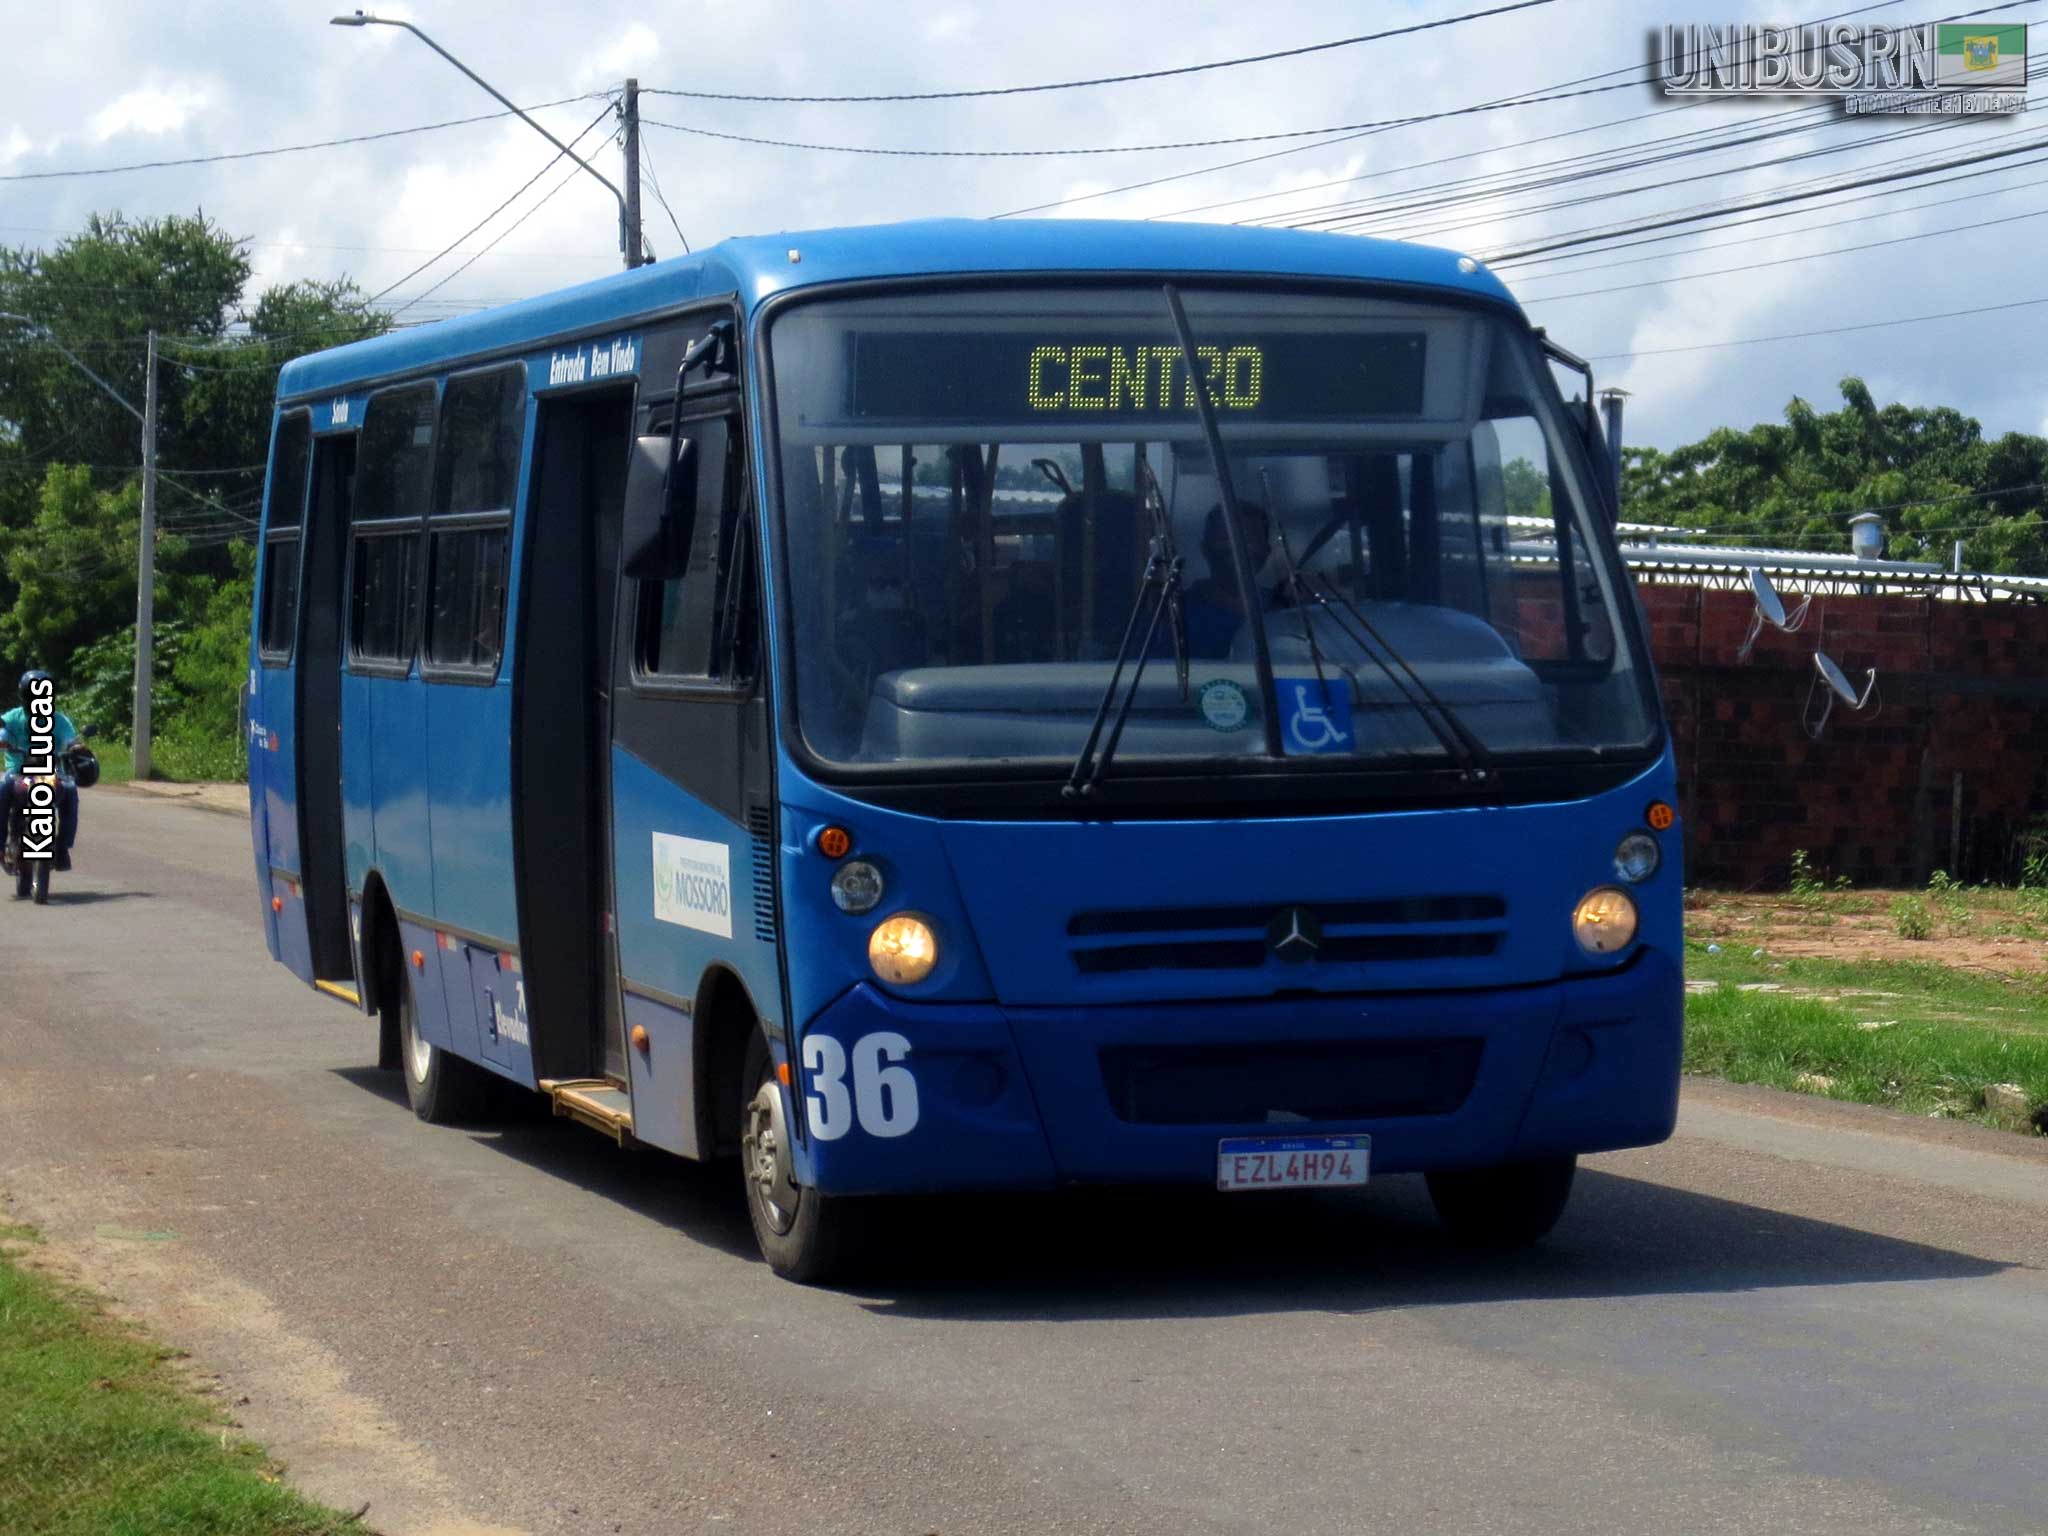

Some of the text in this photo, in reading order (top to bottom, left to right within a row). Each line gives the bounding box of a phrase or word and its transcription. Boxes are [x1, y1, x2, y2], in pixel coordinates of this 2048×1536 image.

[550, 336, 635, 385] Entrada Bem Vindo
[1028, 346, 1262, 407] CENTRO
[675, 870, 729, 917] MOSSORÓ
[802, 1031, 920, 1140] 36
[1233, 1152, 1353, 1184] EZL4H94
